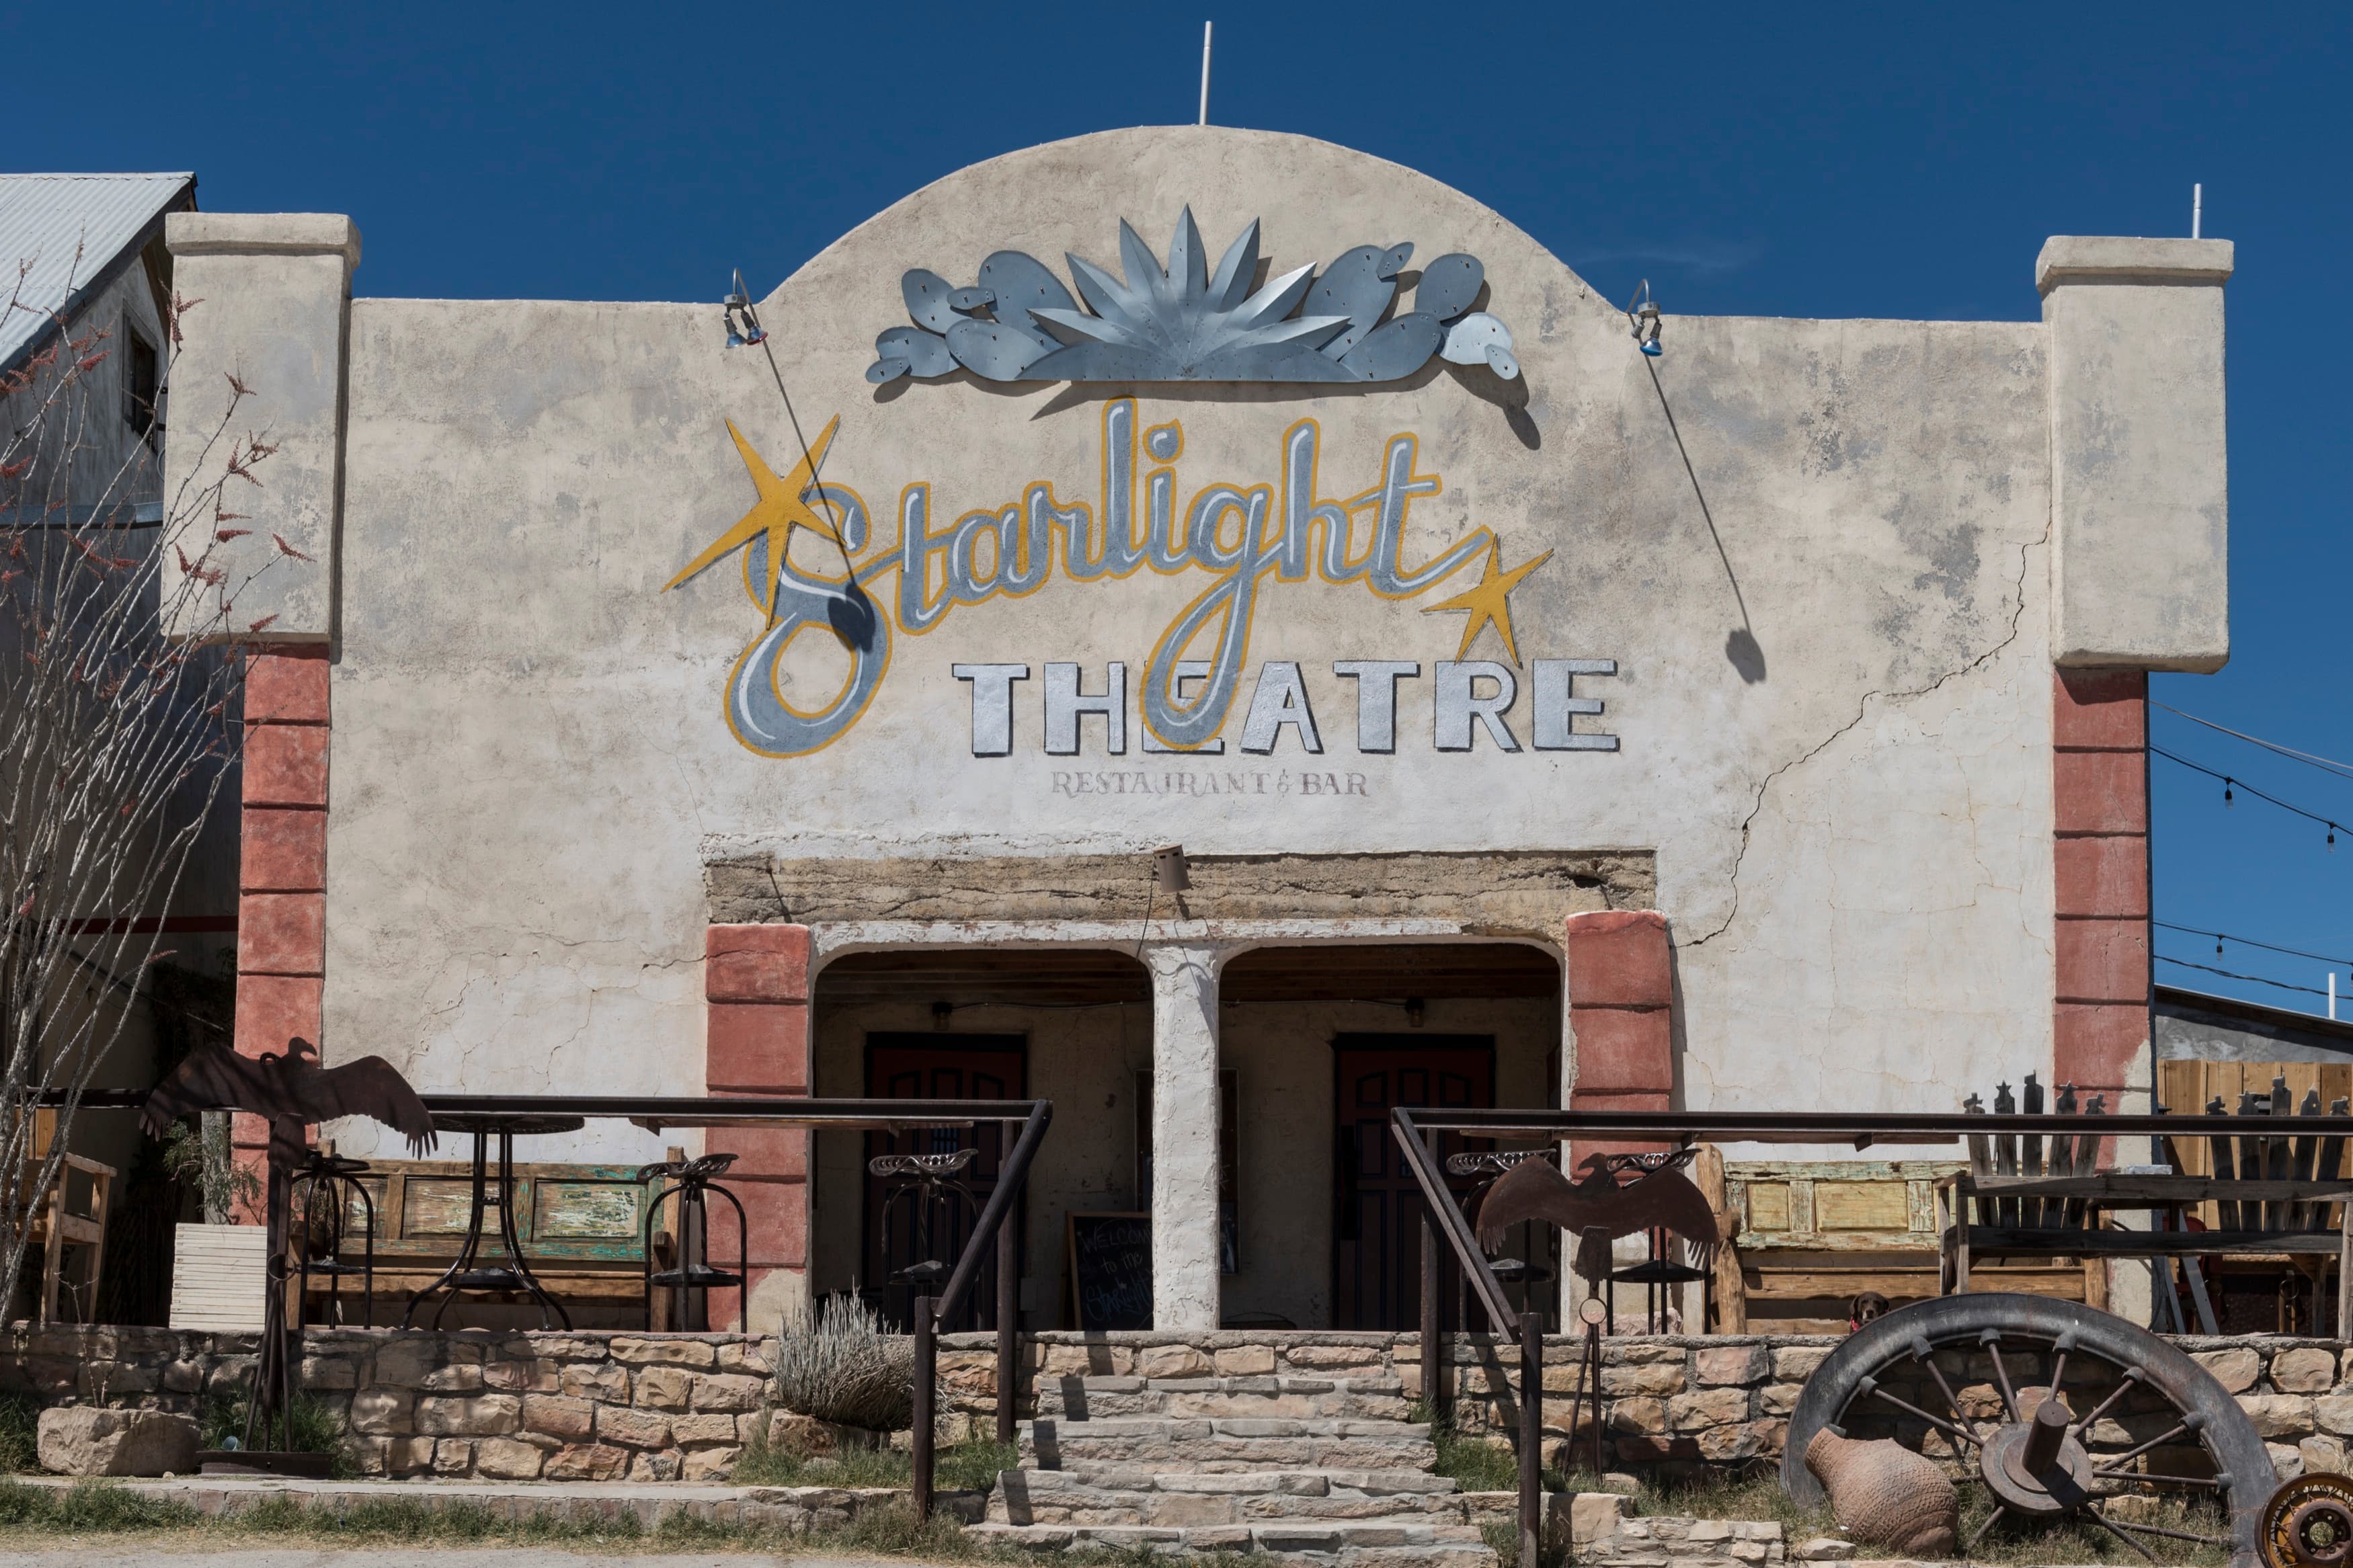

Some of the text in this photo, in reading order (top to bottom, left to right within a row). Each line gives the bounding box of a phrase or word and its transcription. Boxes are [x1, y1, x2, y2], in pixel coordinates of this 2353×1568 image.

[723, 395, 1492, 757] Starlight
[951, 659, 1620, 757] THEATRE
[1051, 771, 1271, 798] RESTAURANT
[1299, 772, 1370, 797] BAR
[1080, 1226, 1152, 1253] WELCOM
